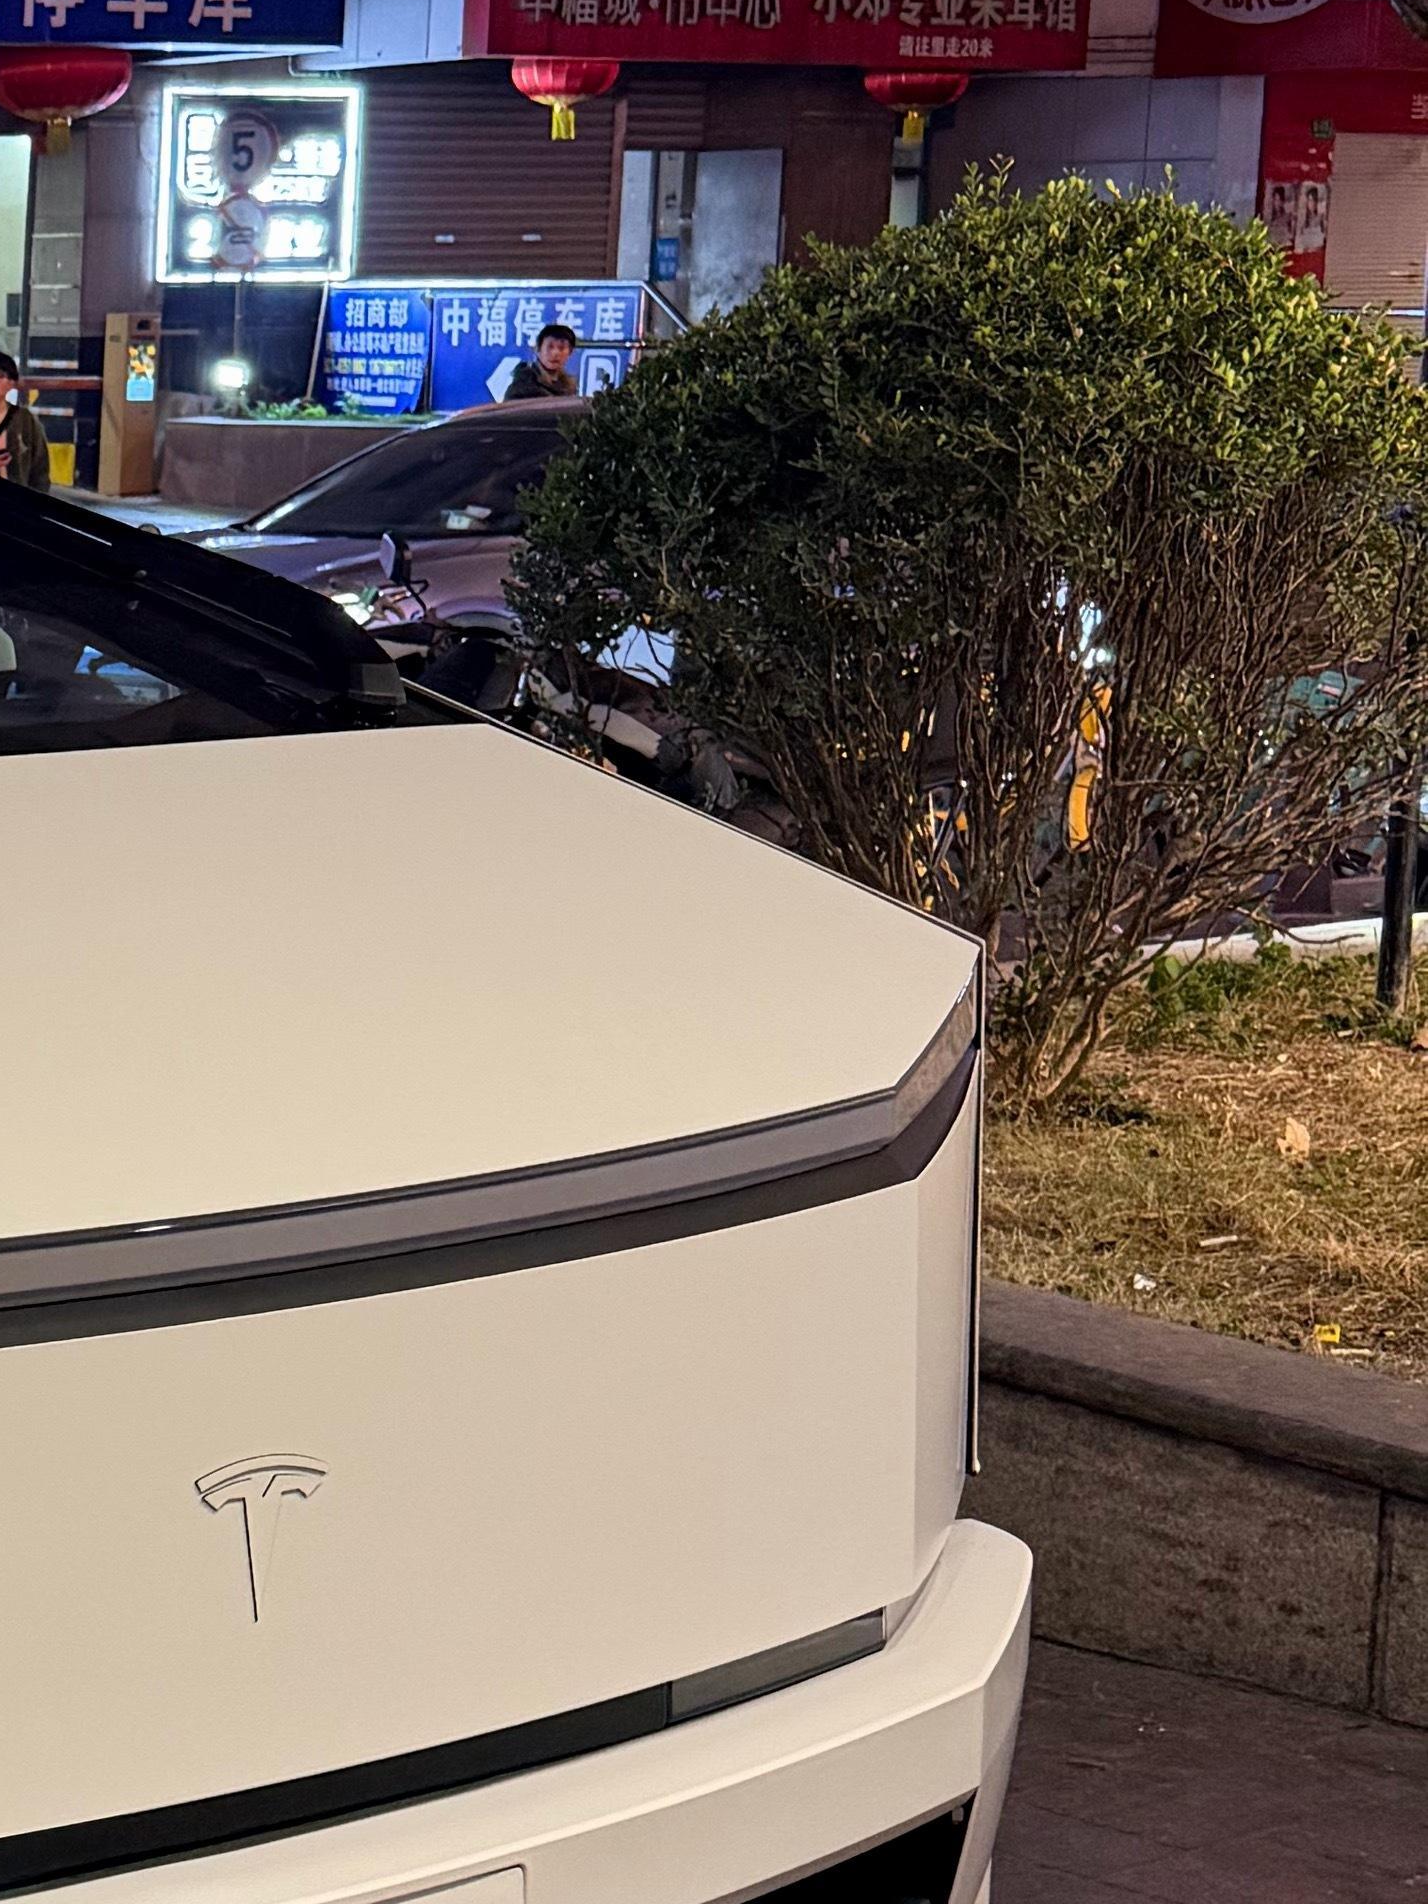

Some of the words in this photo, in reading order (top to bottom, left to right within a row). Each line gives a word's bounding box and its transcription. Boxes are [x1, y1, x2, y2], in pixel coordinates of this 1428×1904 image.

[232, 131, 255, 172] 5
[345, 297, 409, 328] 招商部
[442, 297, 627, 347] 中福停车库
